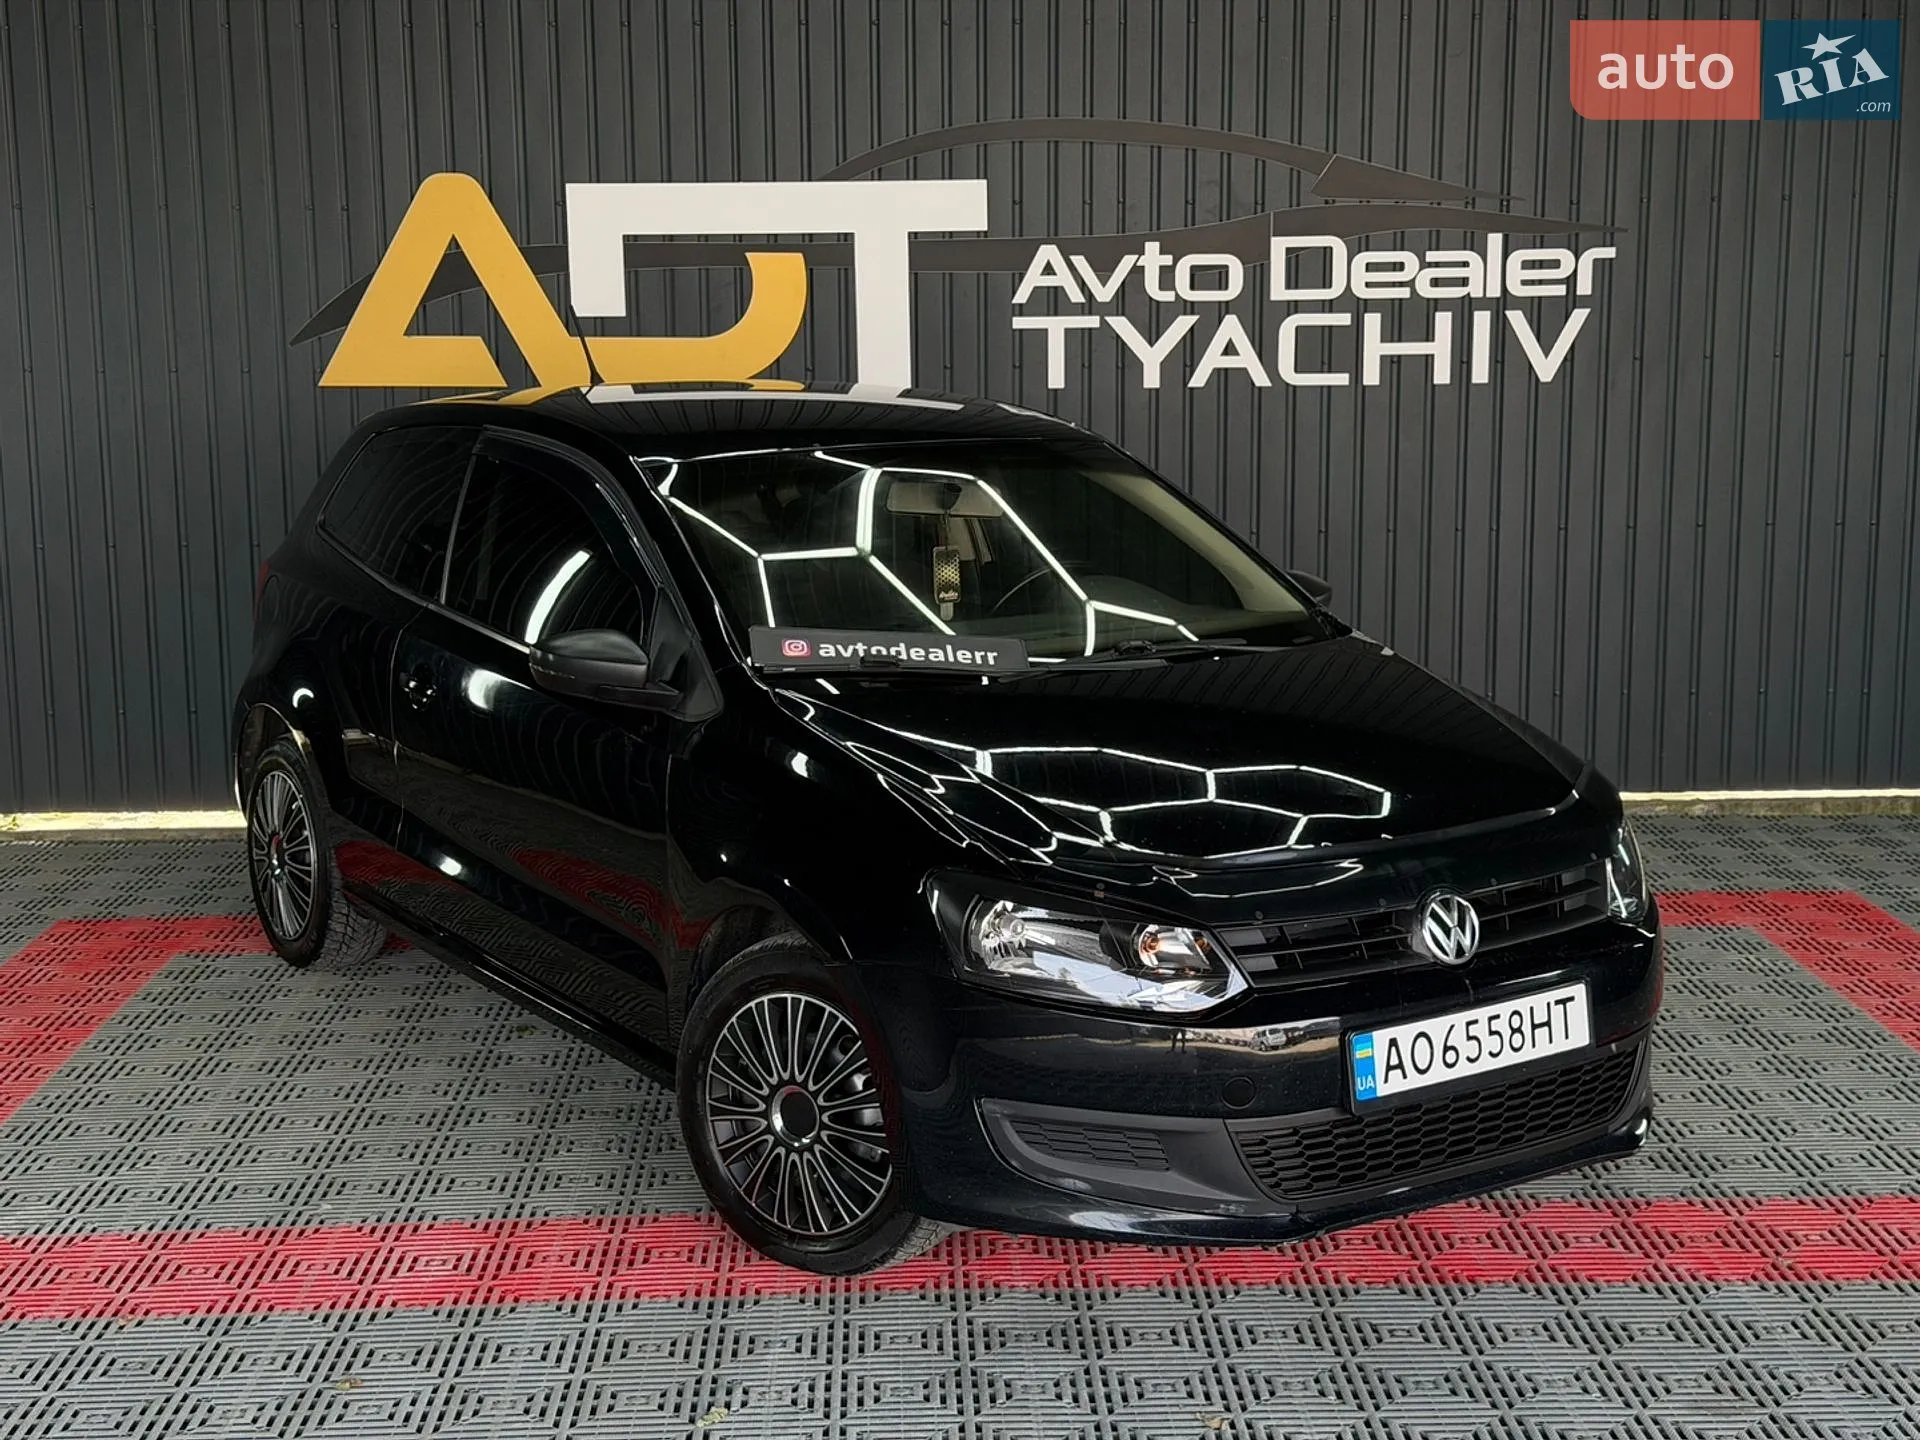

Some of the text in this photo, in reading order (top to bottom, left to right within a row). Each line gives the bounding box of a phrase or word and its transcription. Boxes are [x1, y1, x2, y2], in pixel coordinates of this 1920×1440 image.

[317, 172, 988, 390] ADT
[1011, 233, 1616, 303] Avto Dealer
[1011, 308, 1591, 389] TYACHIV
[1356, 996, 1575, 1091] UA AO6558HT
